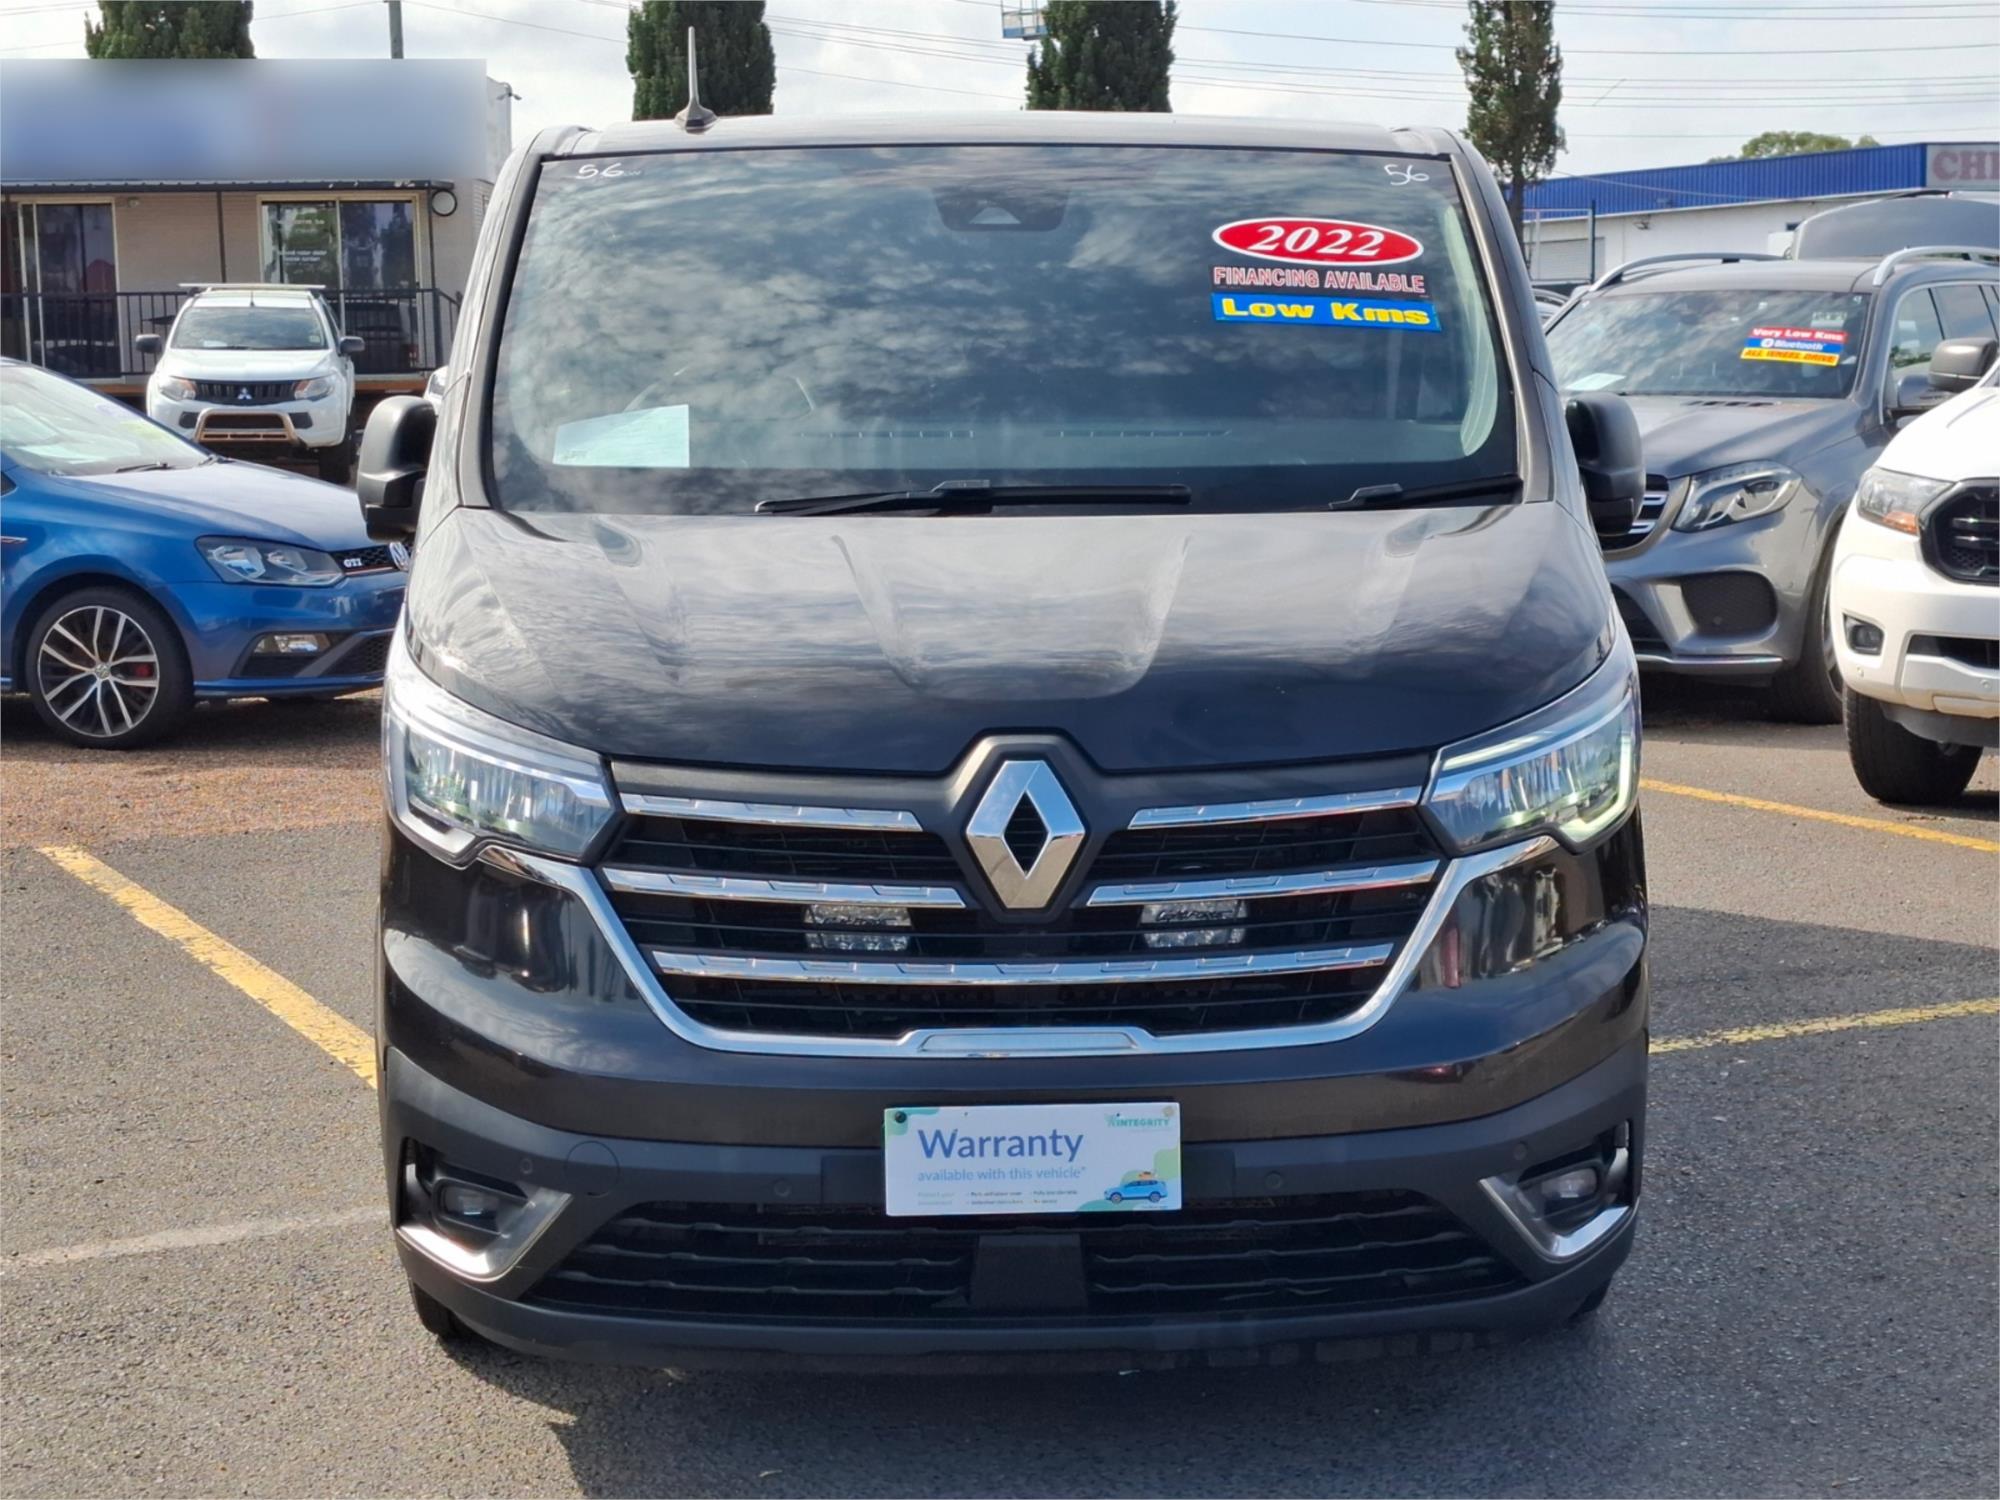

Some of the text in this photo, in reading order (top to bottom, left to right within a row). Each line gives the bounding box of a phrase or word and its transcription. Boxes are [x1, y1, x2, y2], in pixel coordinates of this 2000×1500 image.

[1384, 164, 1430, 186] 56
[1247, 225, 1385, 257] 2022
[1213, 266, 1425, 294] FINANCING AVAILABLE
[1221, 298, 1431, 325] Low Kms
[917, 1128, 1084, 1162] Warranty
[917, 1169, 974, 1182] available
[977, 1168, 1006, 1181] with
[1009, 1167, 1032, 1180] this
